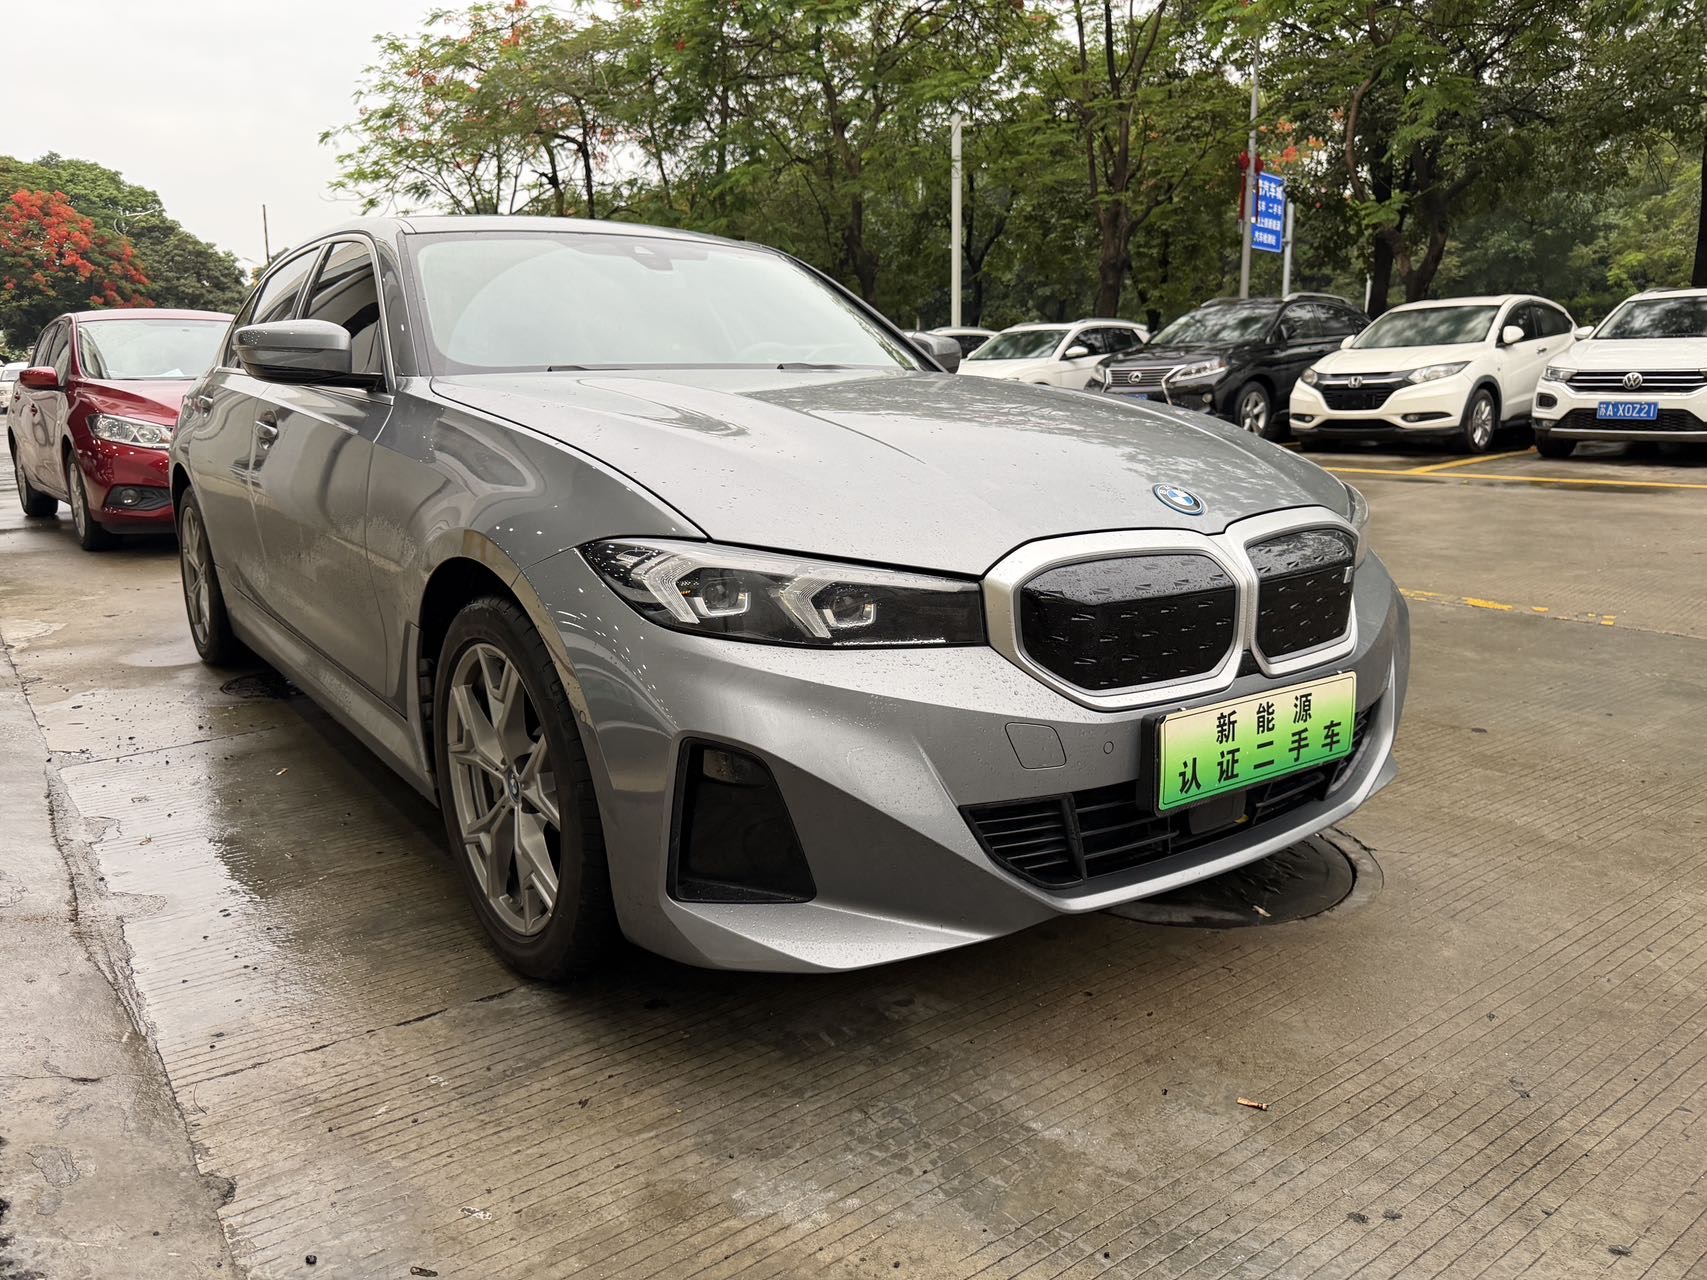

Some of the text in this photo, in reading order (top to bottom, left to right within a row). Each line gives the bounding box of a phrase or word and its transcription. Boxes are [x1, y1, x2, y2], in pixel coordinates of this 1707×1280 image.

[1216, 692, 1312, 744] 新能源
[1178, 720, 1341, 794] 认证二手车
